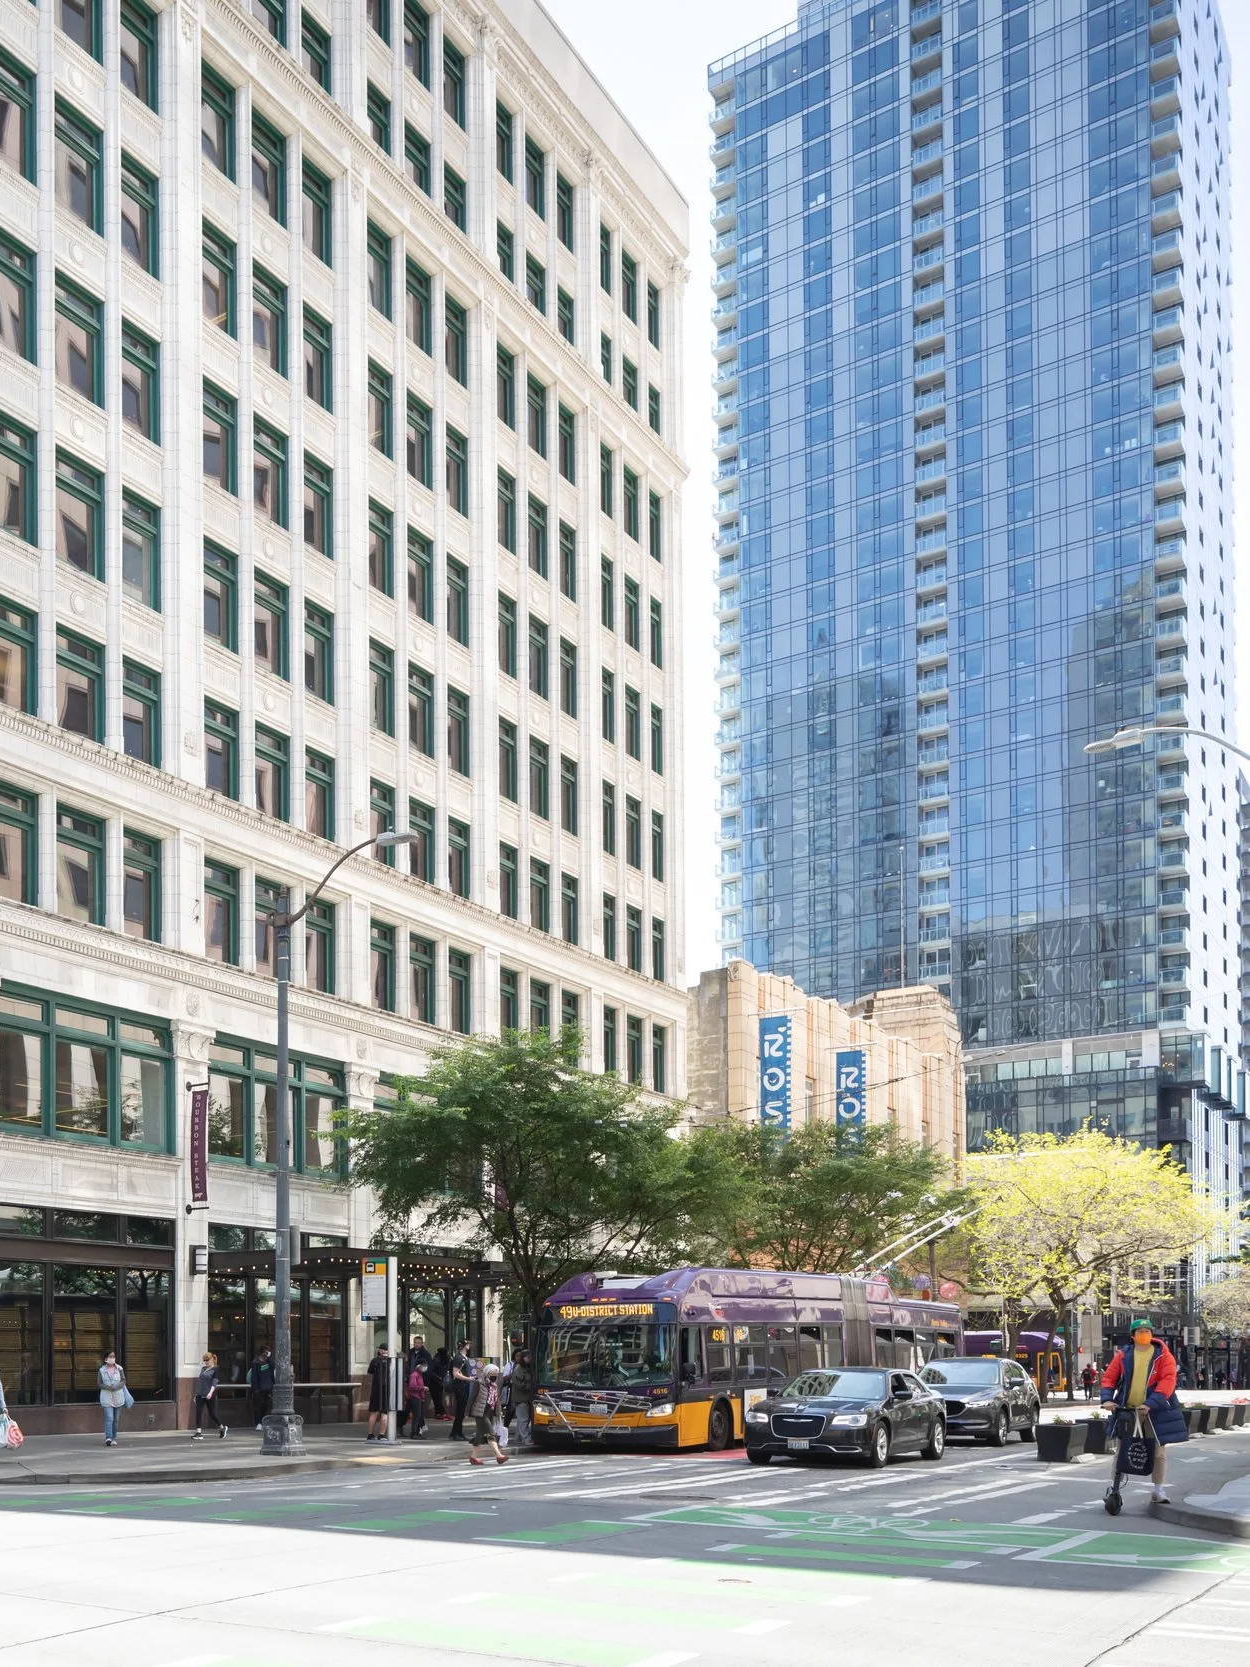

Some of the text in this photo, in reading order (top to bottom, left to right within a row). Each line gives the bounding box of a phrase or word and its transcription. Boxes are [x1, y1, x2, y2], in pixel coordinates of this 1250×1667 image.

[763, 1034, 785, 1125] ROS
[559, 1303, 654, 1319] 49 U-DISTRICT STATION
[652, 1387, 668, 1395] 4516
